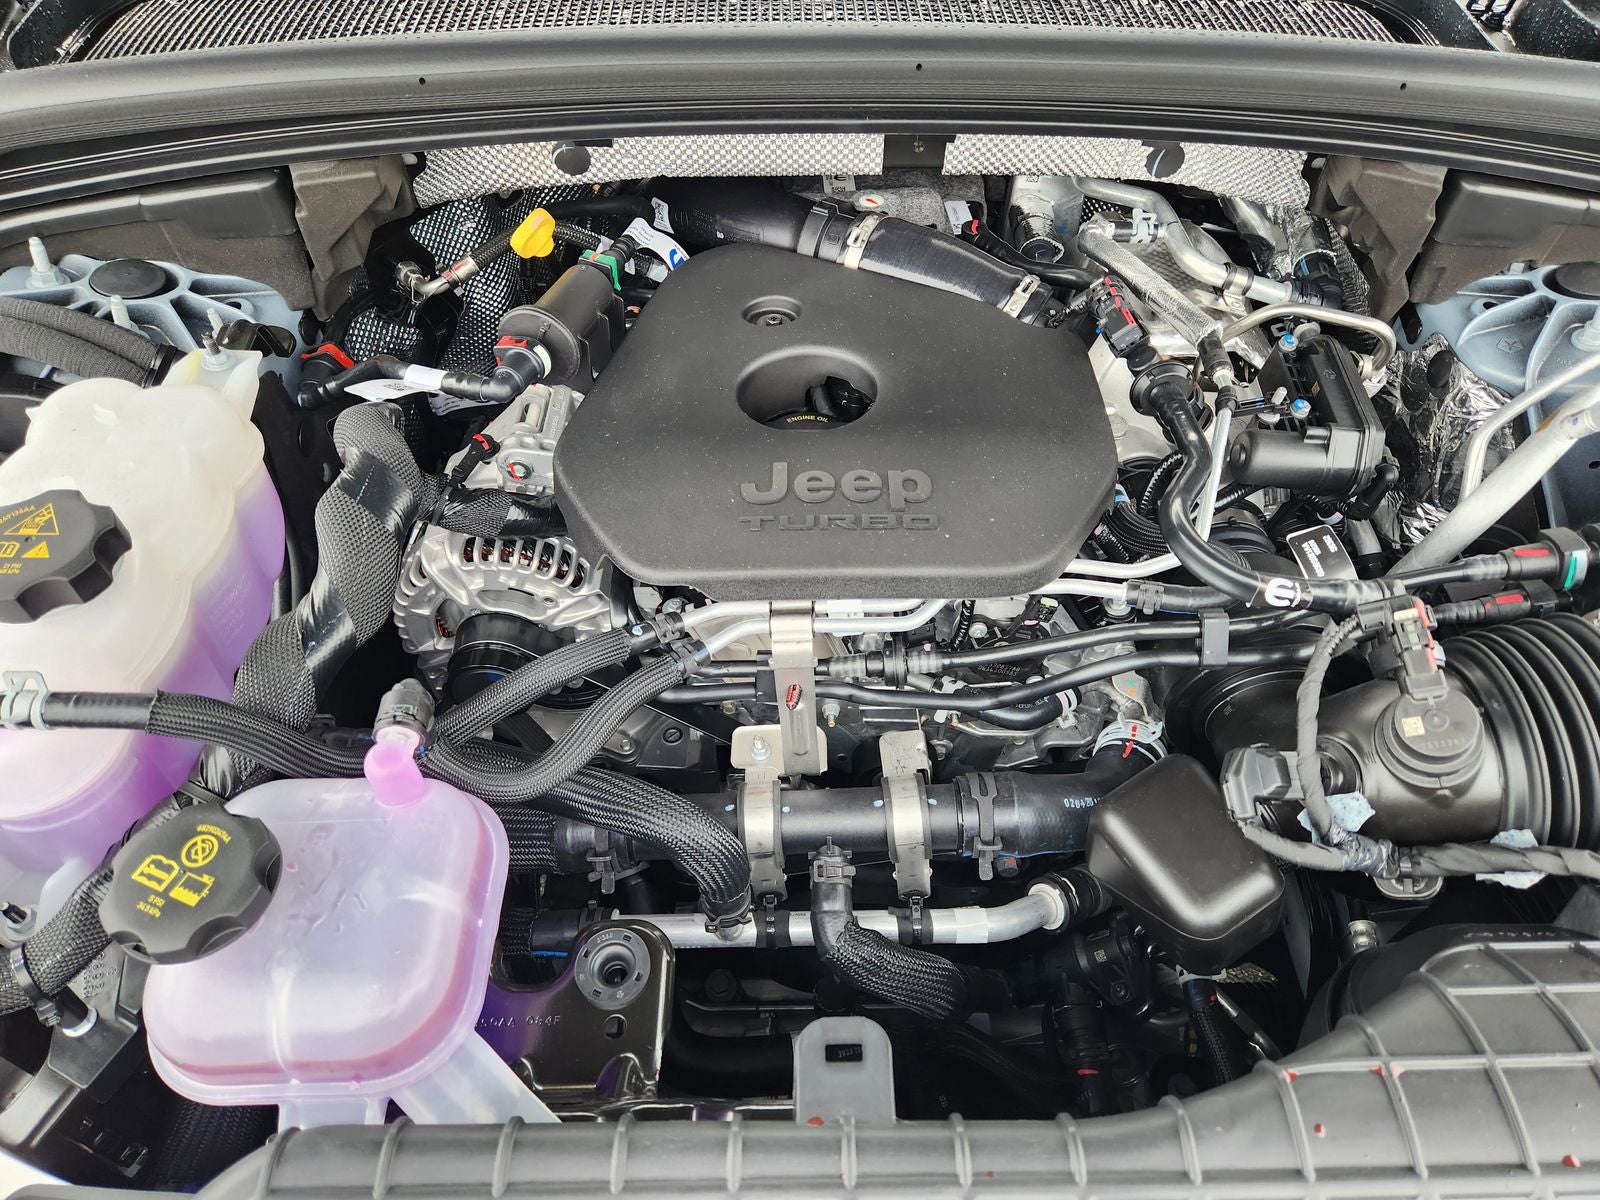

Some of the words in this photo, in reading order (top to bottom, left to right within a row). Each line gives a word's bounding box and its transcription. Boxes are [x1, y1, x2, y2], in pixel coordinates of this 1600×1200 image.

[786, 414, 816, 424] ENGINE
[816, 415, 829, 424] OIL
[741, 461, 933, 512] Jeep
[737, 513, 939, 531] TURBO
